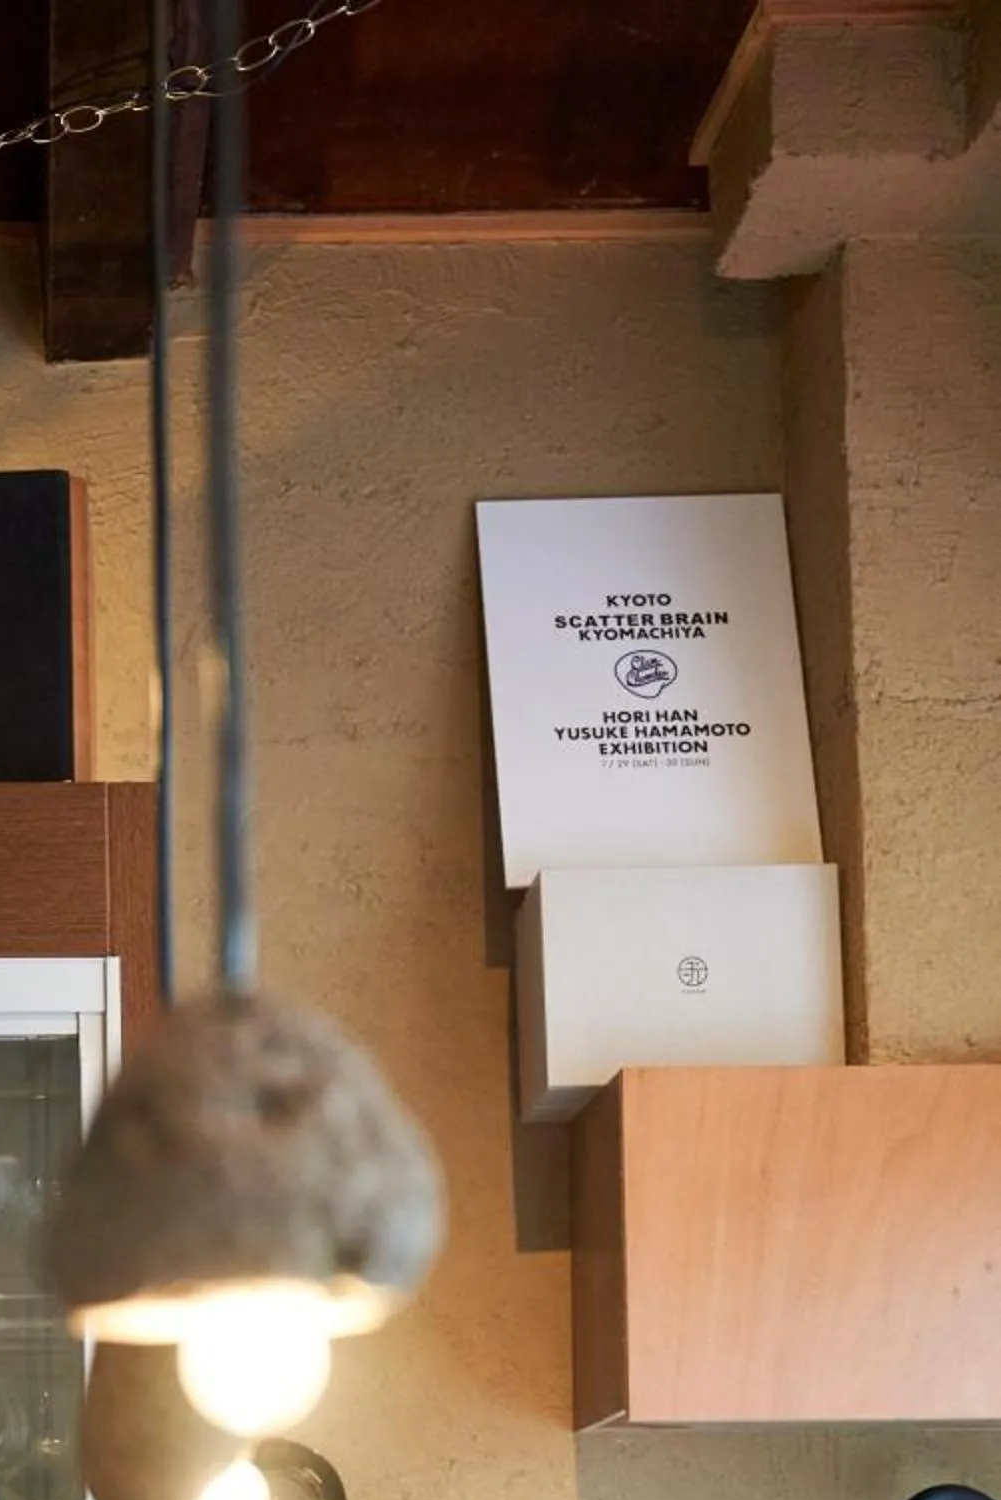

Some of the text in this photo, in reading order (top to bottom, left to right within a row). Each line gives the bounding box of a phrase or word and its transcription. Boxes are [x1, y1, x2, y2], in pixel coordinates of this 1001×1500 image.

[605, 593, 672, 607] KYOTO
[554, 611, 729, 629] SCATTER BRAIN
[578, 626, 706, 641] KYOMACHIYA
[602, 709, 698, 724] HORI HAN
[553, 722, 751, 741] YUSUKE HAMAMOTO
[598, 740, 708, 756] EXHIBITION
